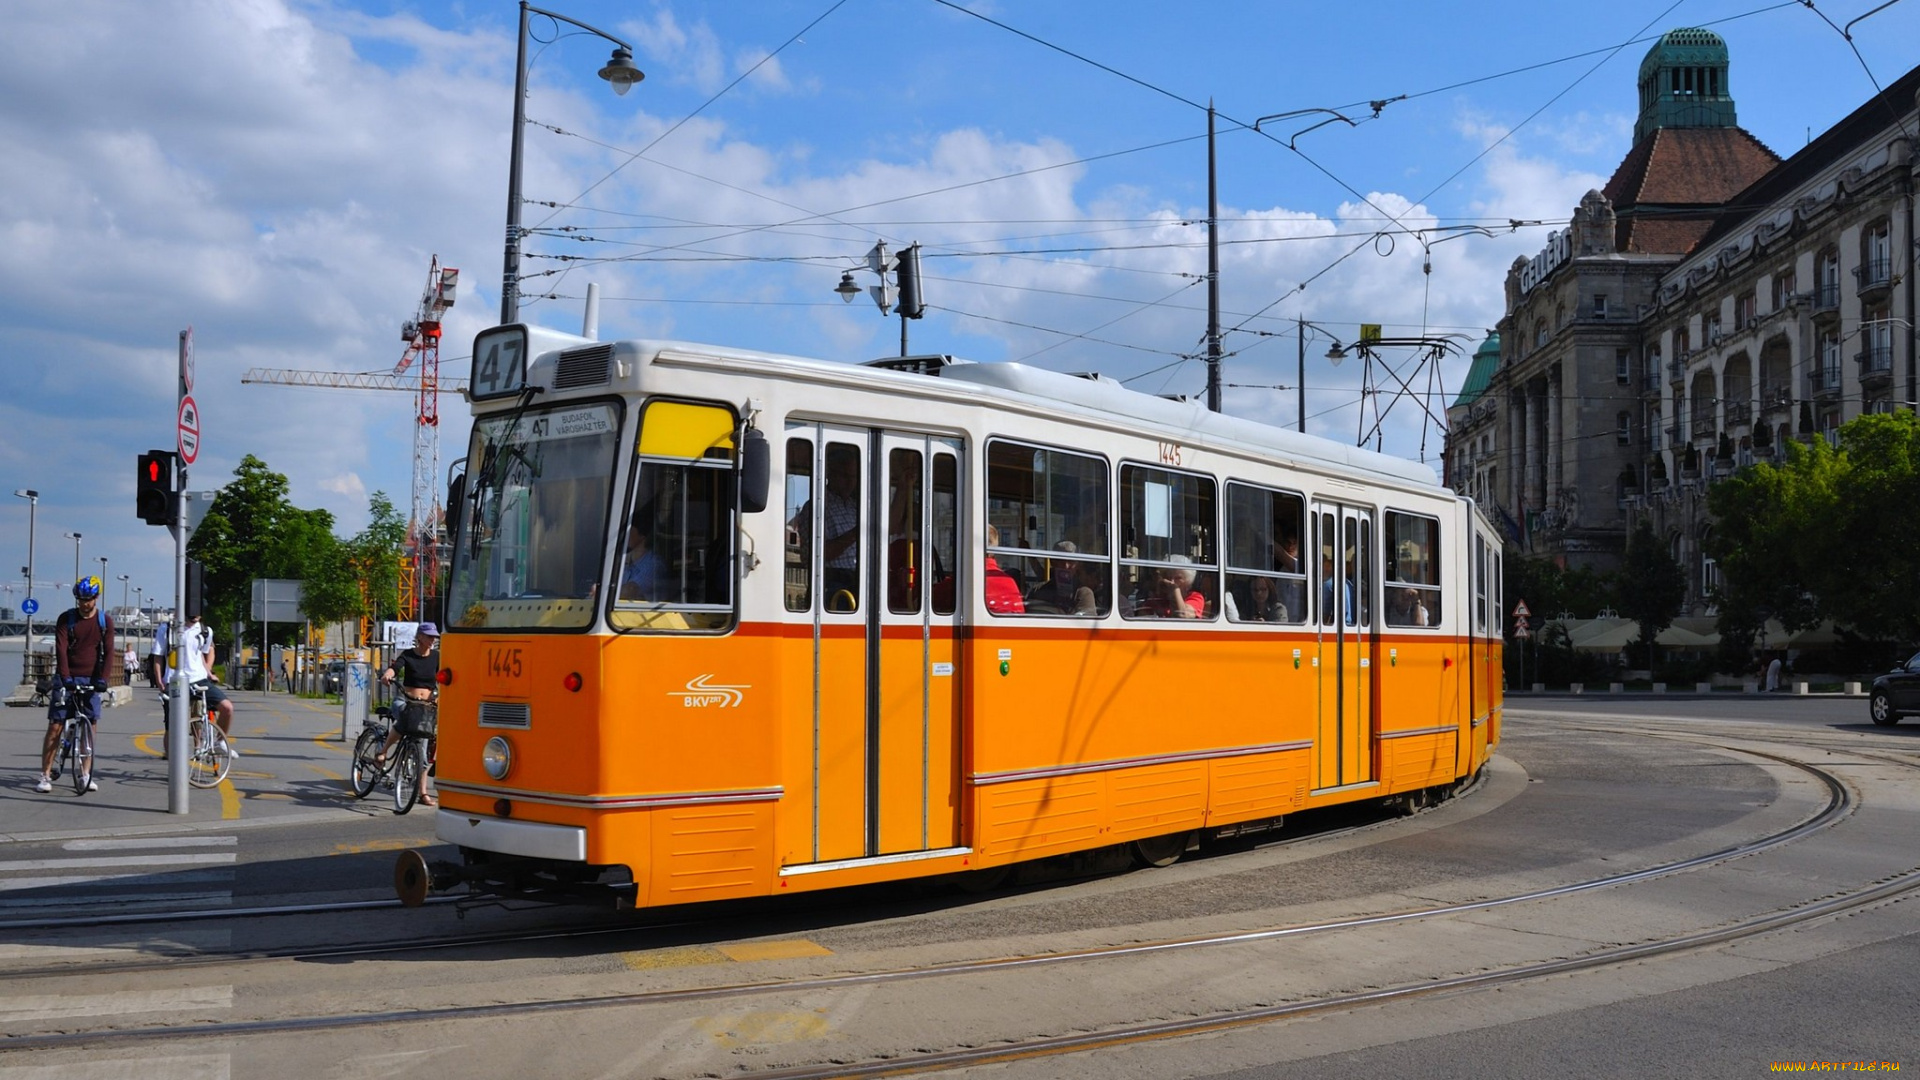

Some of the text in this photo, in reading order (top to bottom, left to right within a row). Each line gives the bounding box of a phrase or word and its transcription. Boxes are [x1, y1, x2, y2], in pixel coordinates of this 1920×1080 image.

[479, 338, 523, 392] 47
[532, 418, 549, 437] 47
[1158, 441, 1181, 466] 1445
[487, 648, 523, 678] 1445
